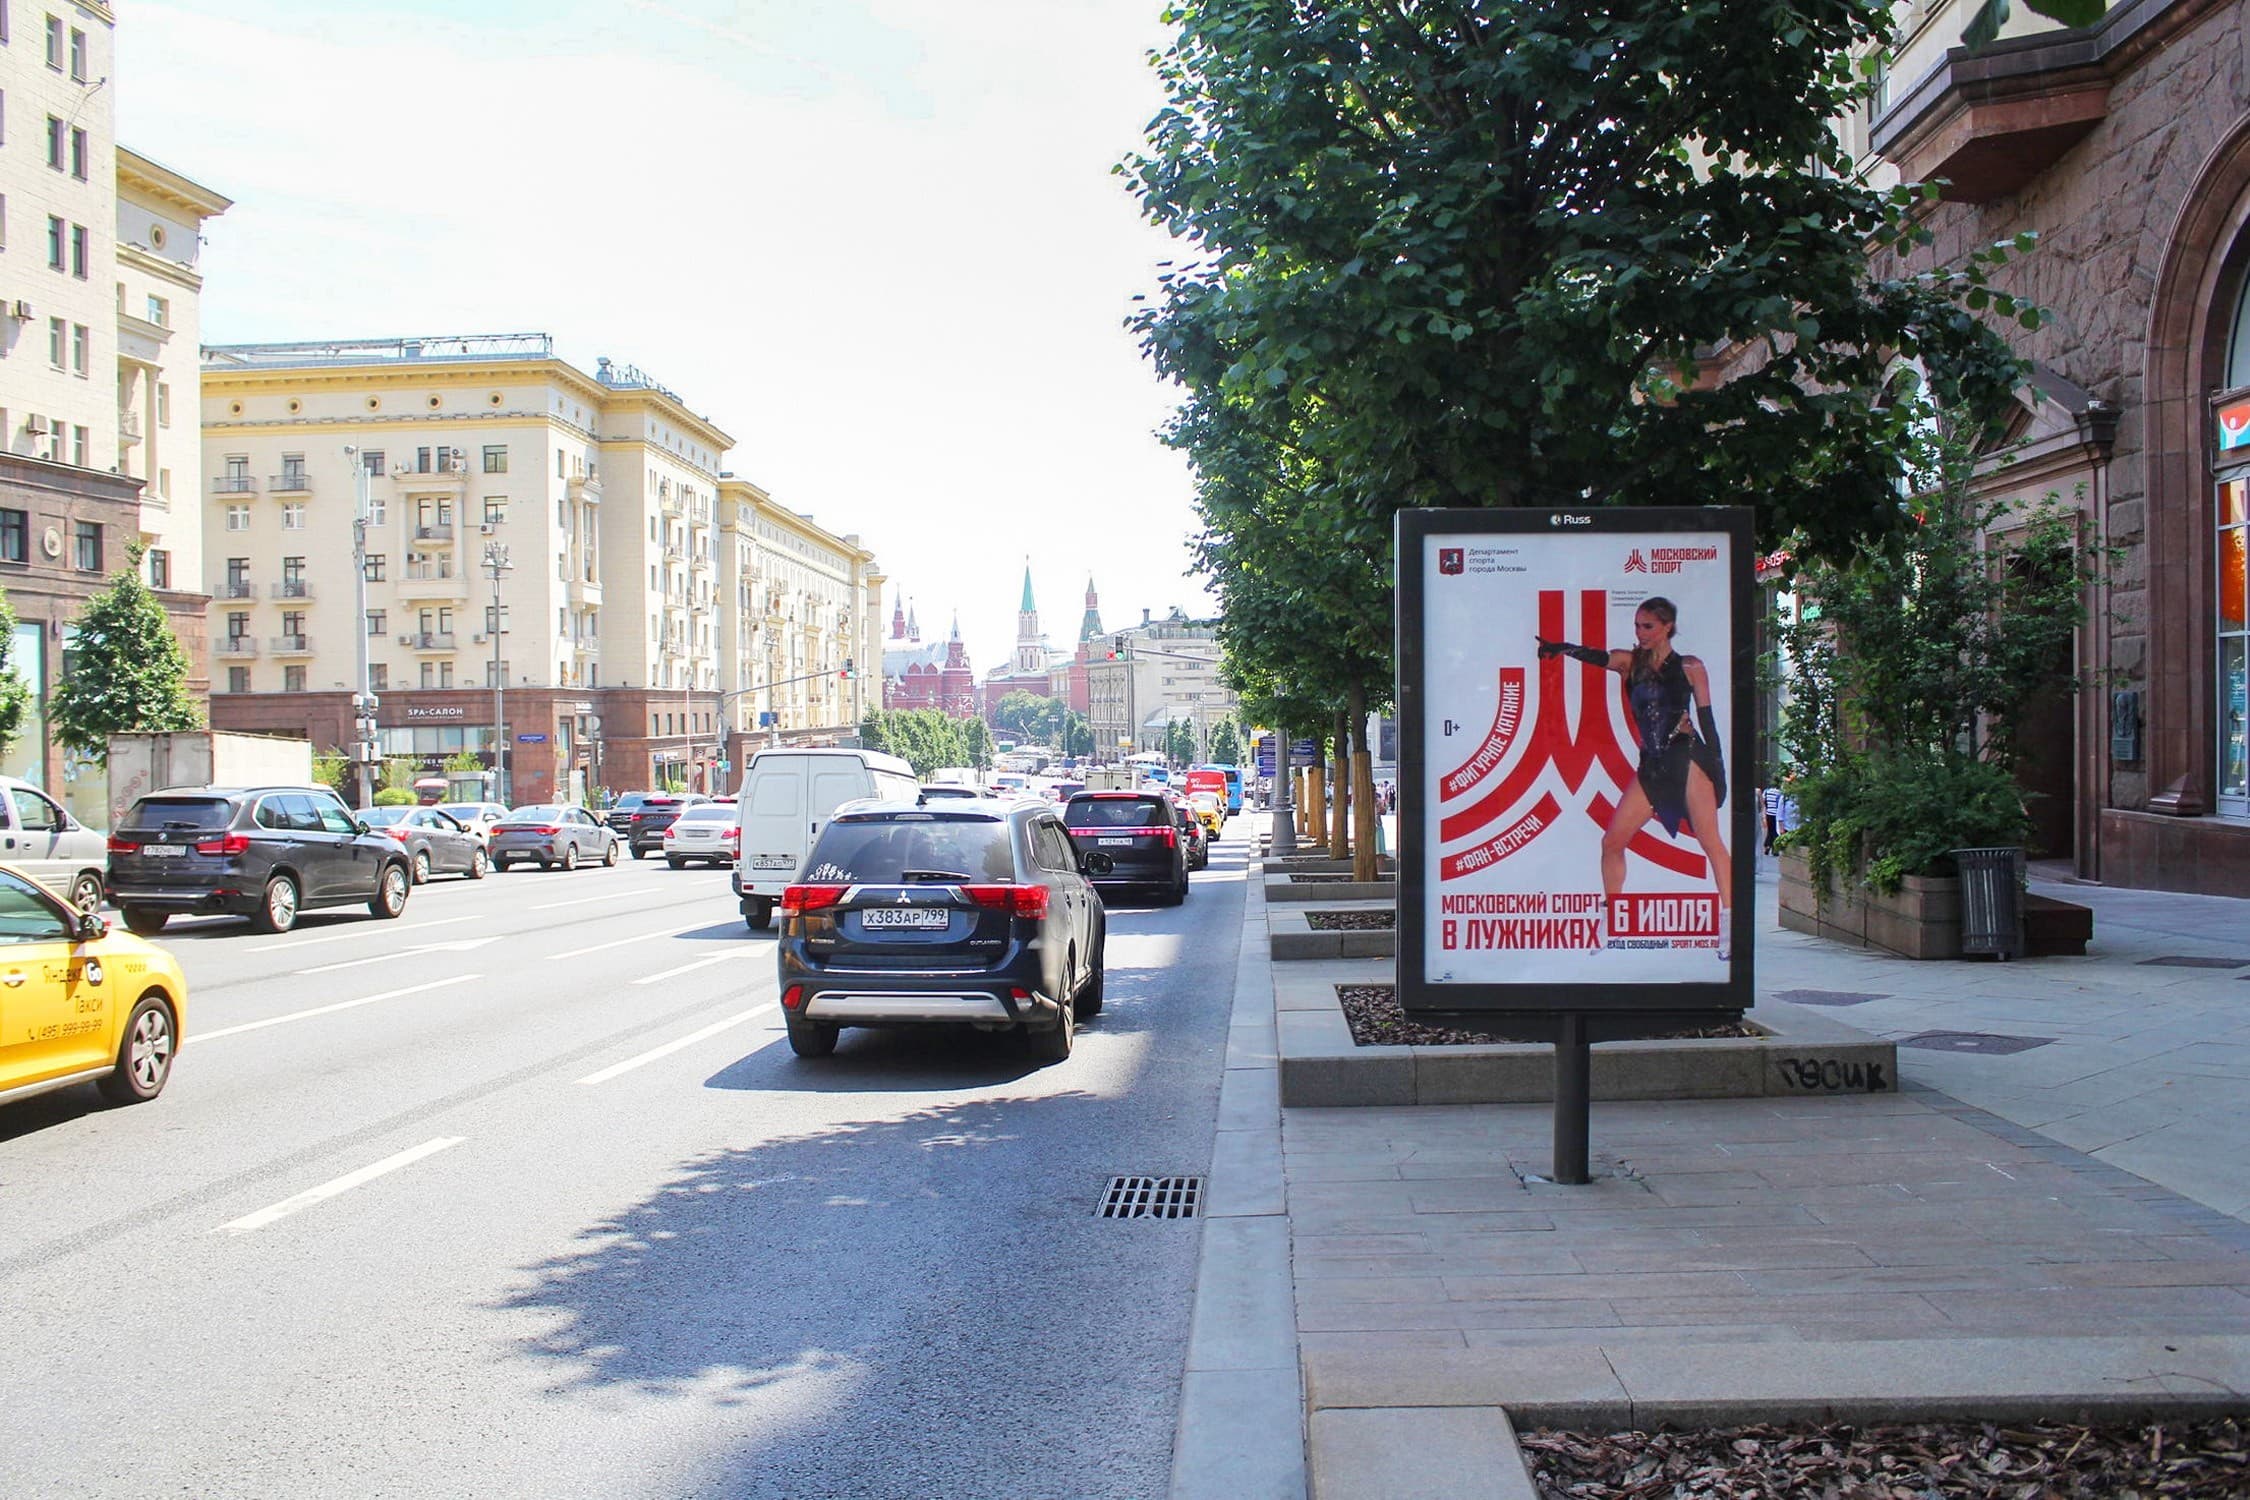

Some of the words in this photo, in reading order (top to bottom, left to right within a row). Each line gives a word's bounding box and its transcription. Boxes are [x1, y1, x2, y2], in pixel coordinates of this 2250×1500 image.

[1563, 514, 1591, 525] Russ
[1468, 548, 1519, 557] Департамент
[1651, 545, 1717, 560] МОСКОВСКИЙ
[1468, 557, 1496, 565] спорта
[1651, 561, 1682, 574] СПОРТ
[1444, 719, 1460, 736] 0+
[1448, 734, 1508, 792] #ФИГУРНОЕ
[1495, 681, 1520, 736] КАТАНИЕ
[1456, 814, 1544, 871] #ФАН-ВСТРЕЧИ
[1442, 891, 1546, 914] МОСКОВСКИЙ
[1552, 894, 1601, 913] СПОРТ
[924, 909, 944, 921] 799
[1614, 899, 1629, 932] 6
[1638, 899, 1713, 932] ИЮЛЯ
[1442, 919, 1457, 950] В
[1465, 919, 1601, 949] ЛУЖНИКАХ
[1607, 940, 1626, 950] ВХОД
[1627, 939, 1669, 949] СВОБОДНЫЙ
[1671, 939, 1720, 949] SPORT.MOS.RU
[74, 995, 103, 1014] Такси
